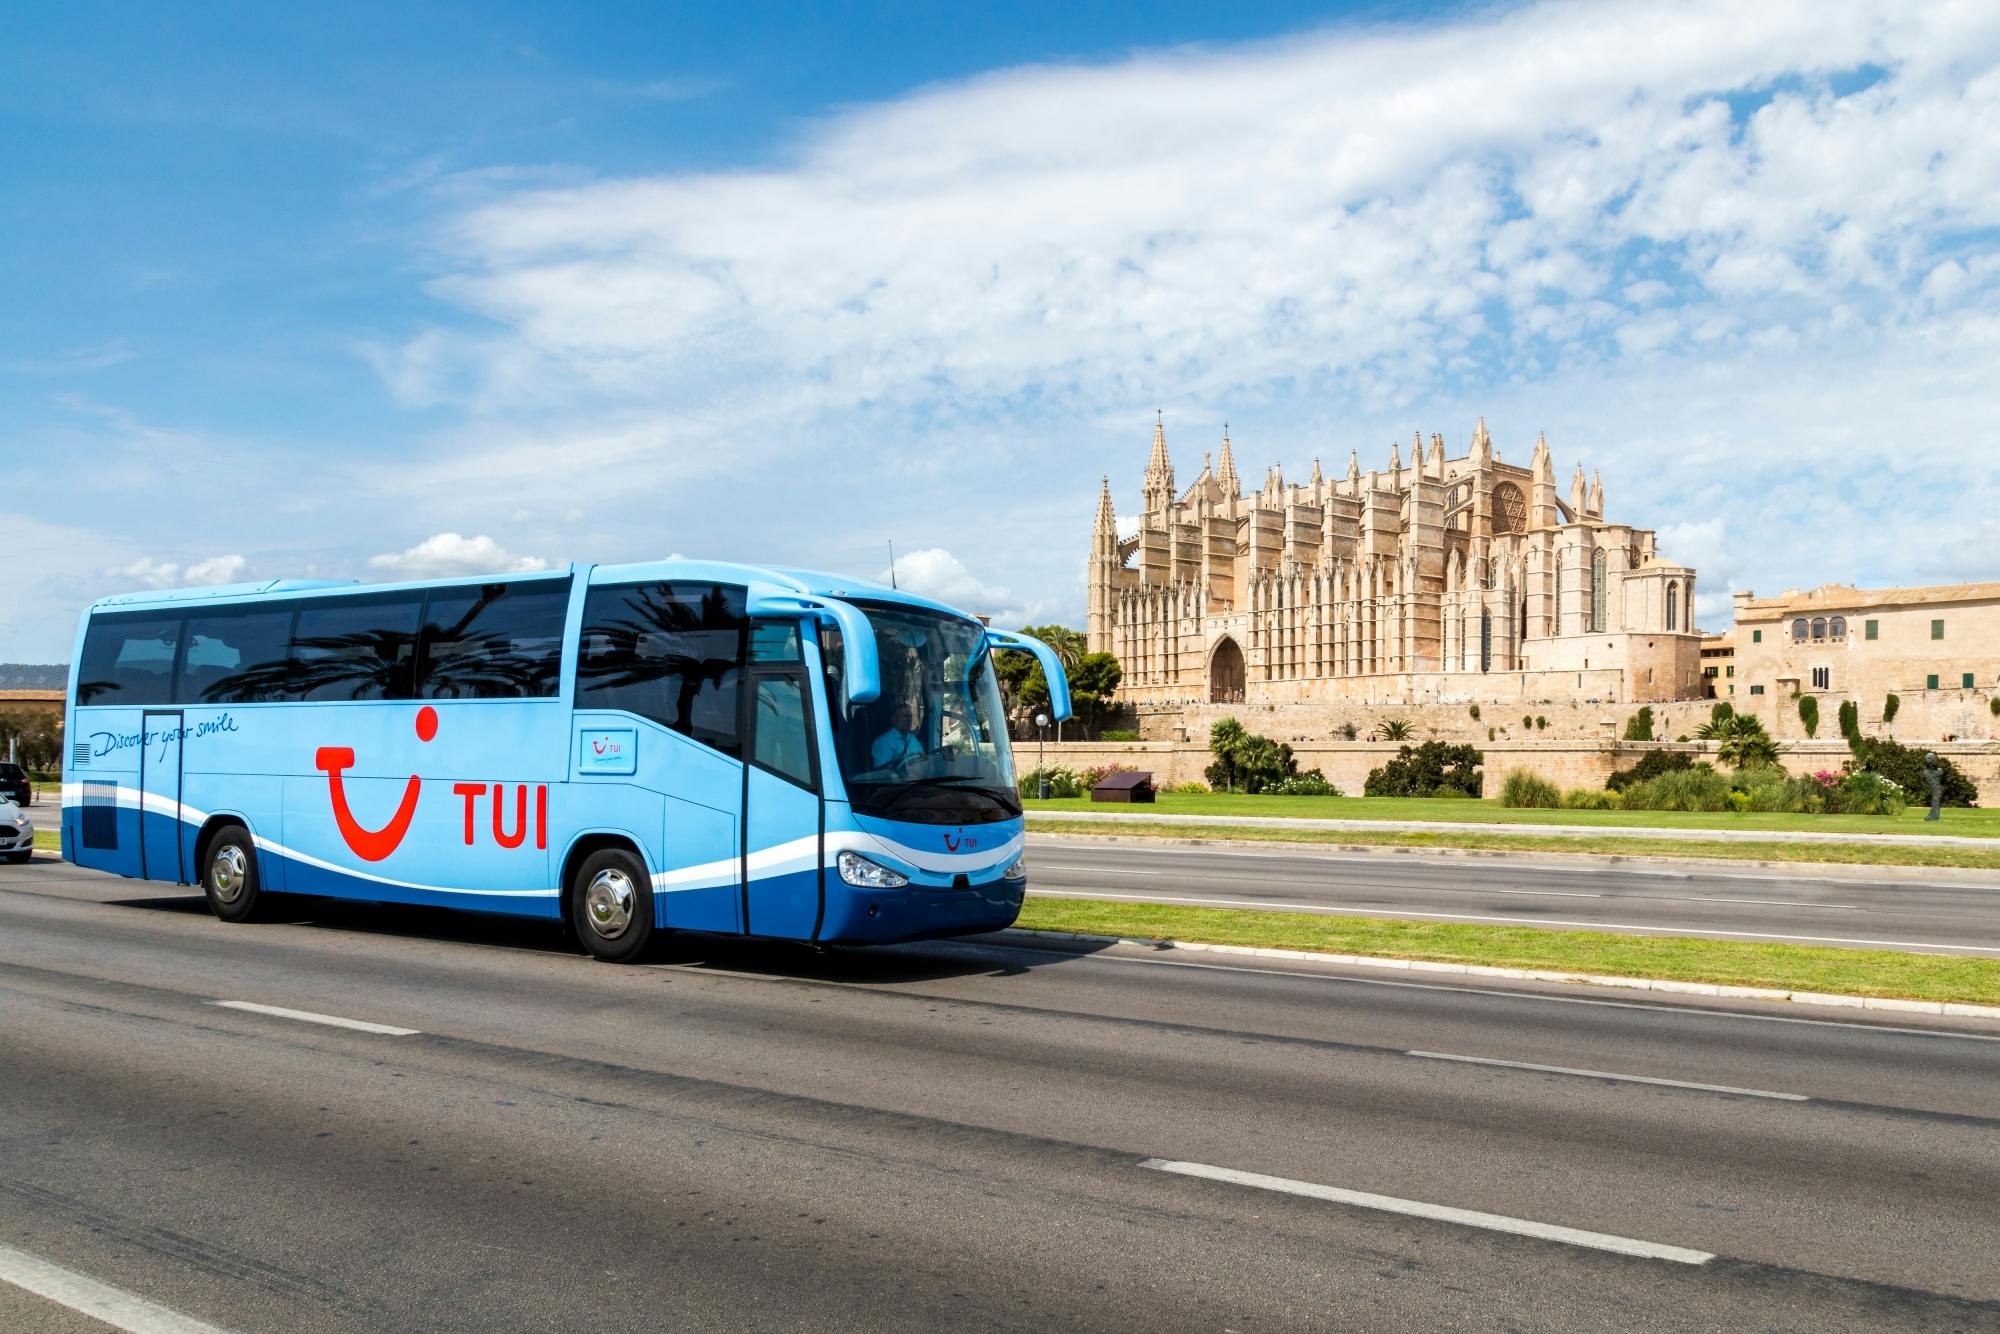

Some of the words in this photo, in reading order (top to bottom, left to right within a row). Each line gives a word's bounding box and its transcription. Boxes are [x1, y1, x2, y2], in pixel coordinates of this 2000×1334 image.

[89, 731, 159, 757] Discover
[159, 727, 193, 763] your
[196, 713, 239, 738] smile
[609, 744, 621, 752] TUI
[453, 783, 547, 850] TUI
[964, 838, 977, 848] TUI
